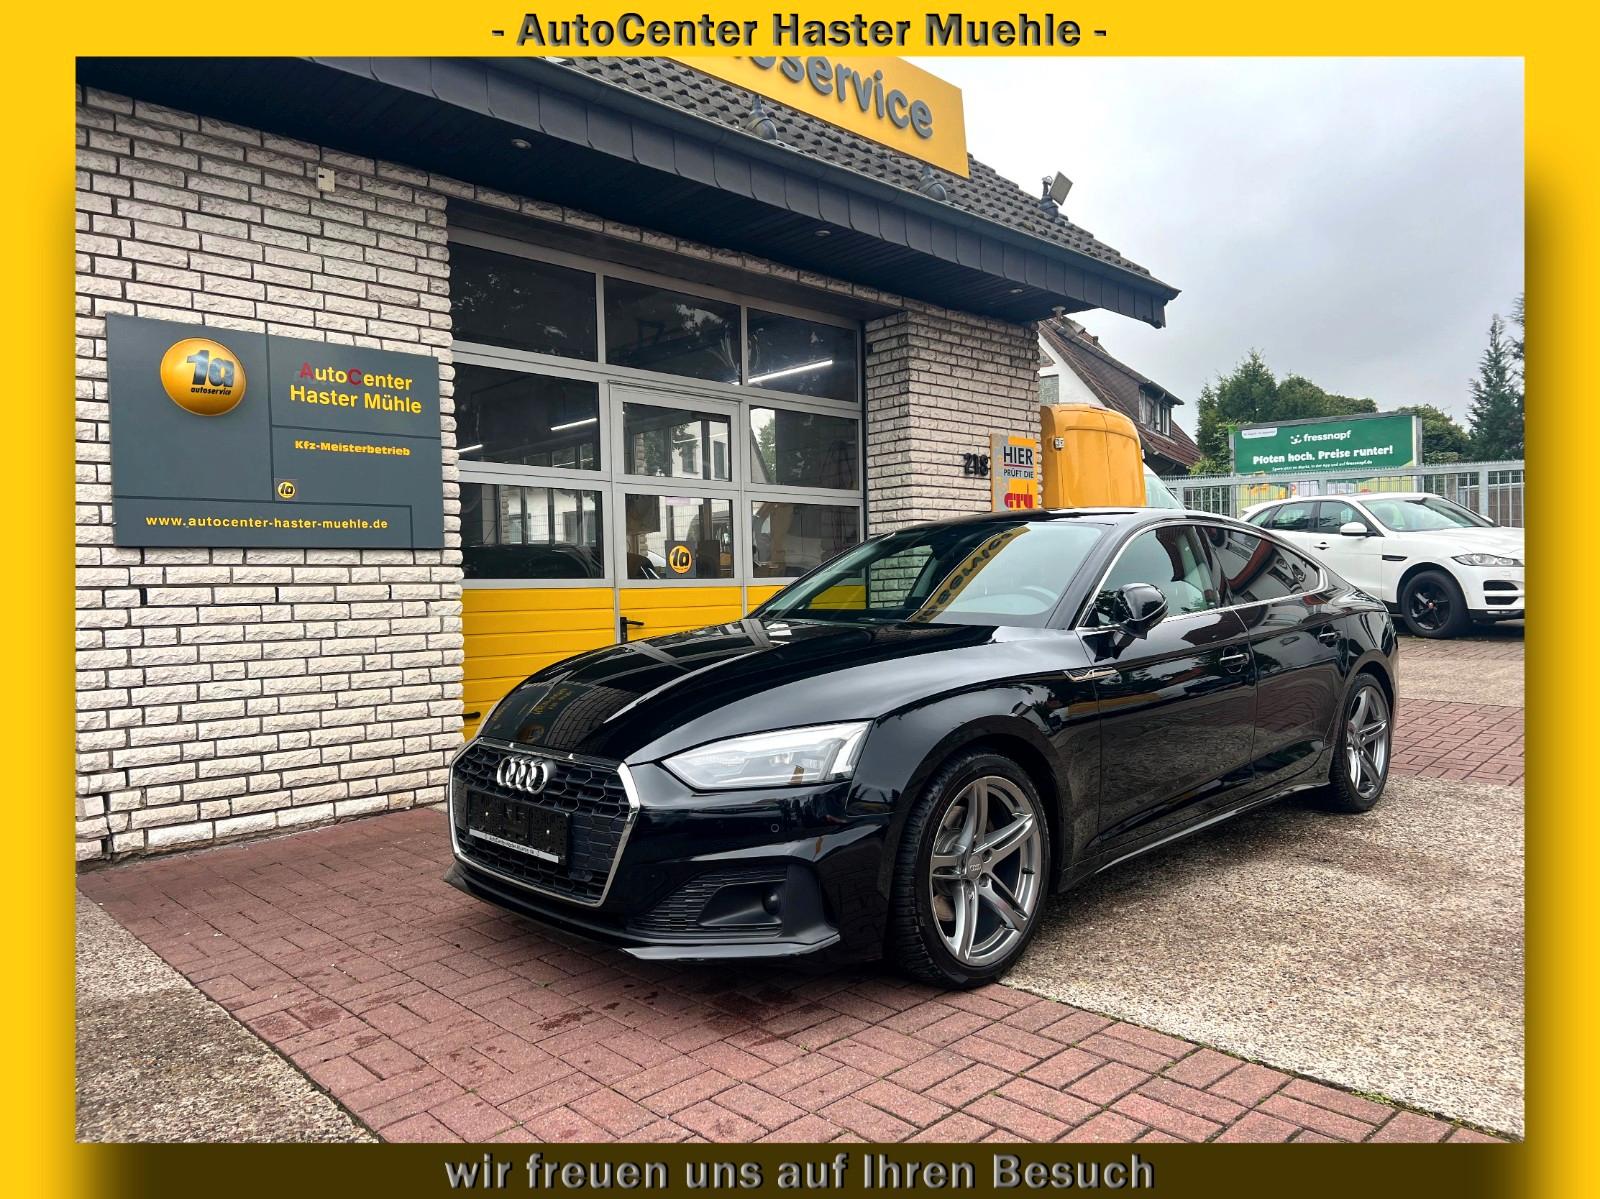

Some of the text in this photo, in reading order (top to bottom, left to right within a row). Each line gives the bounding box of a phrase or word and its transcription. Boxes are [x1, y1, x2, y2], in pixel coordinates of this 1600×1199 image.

[187, 350, 234, 387] 1a
[299, 361, 413, 390] AutoCenter
[190, 387, 232, 396] autoservice
[290, 384, 422, 414] Haster Mühle
[1303, 430, 1352, 443] fressnapf
[294, 440, 411, 456] Kfz-Meisterbetrieb
[1003, 446, 1033, 465] HIER
[1252, 445, 1393, 465] Pfoten hoch. Preise runter!
[1003, 468, 1034, 478] PRÜFT DIE
[146, 515, 389, 530] www.autocenter-haster-muehle.de
[671, 548, 689, 566] 1a
